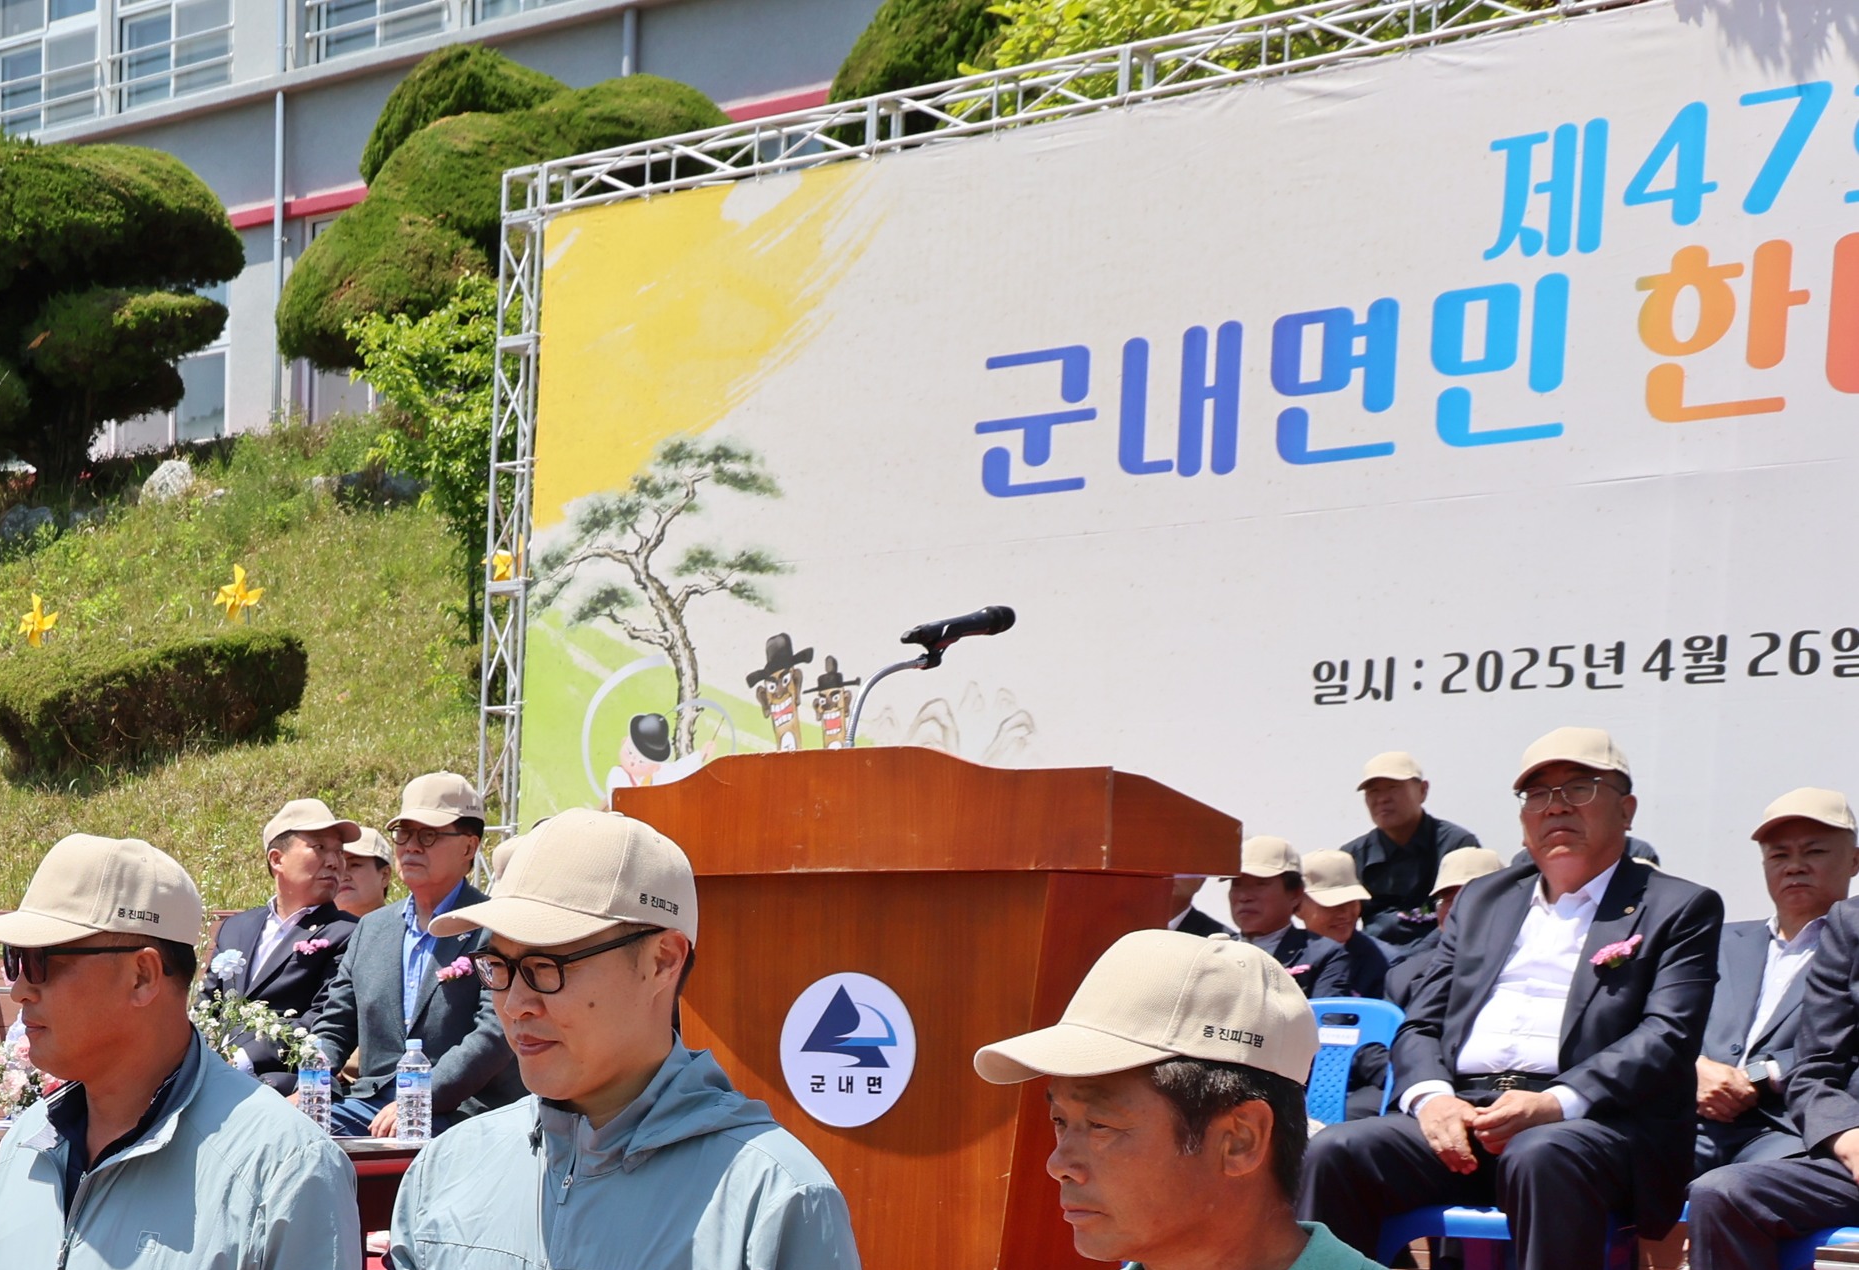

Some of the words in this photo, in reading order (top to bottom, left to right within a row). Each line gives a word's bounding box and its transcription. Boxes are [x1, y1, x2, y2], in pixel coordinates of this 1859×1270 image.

[1482, 80, 1859, 261] 제47
[974, 271, 1570, 499] 군내면민
[1440, 639, 1626, 694] 2025년
[1641, 633, 1728, 685] 4월
[1218, 1027, 1265, 1049] 진피그팜
